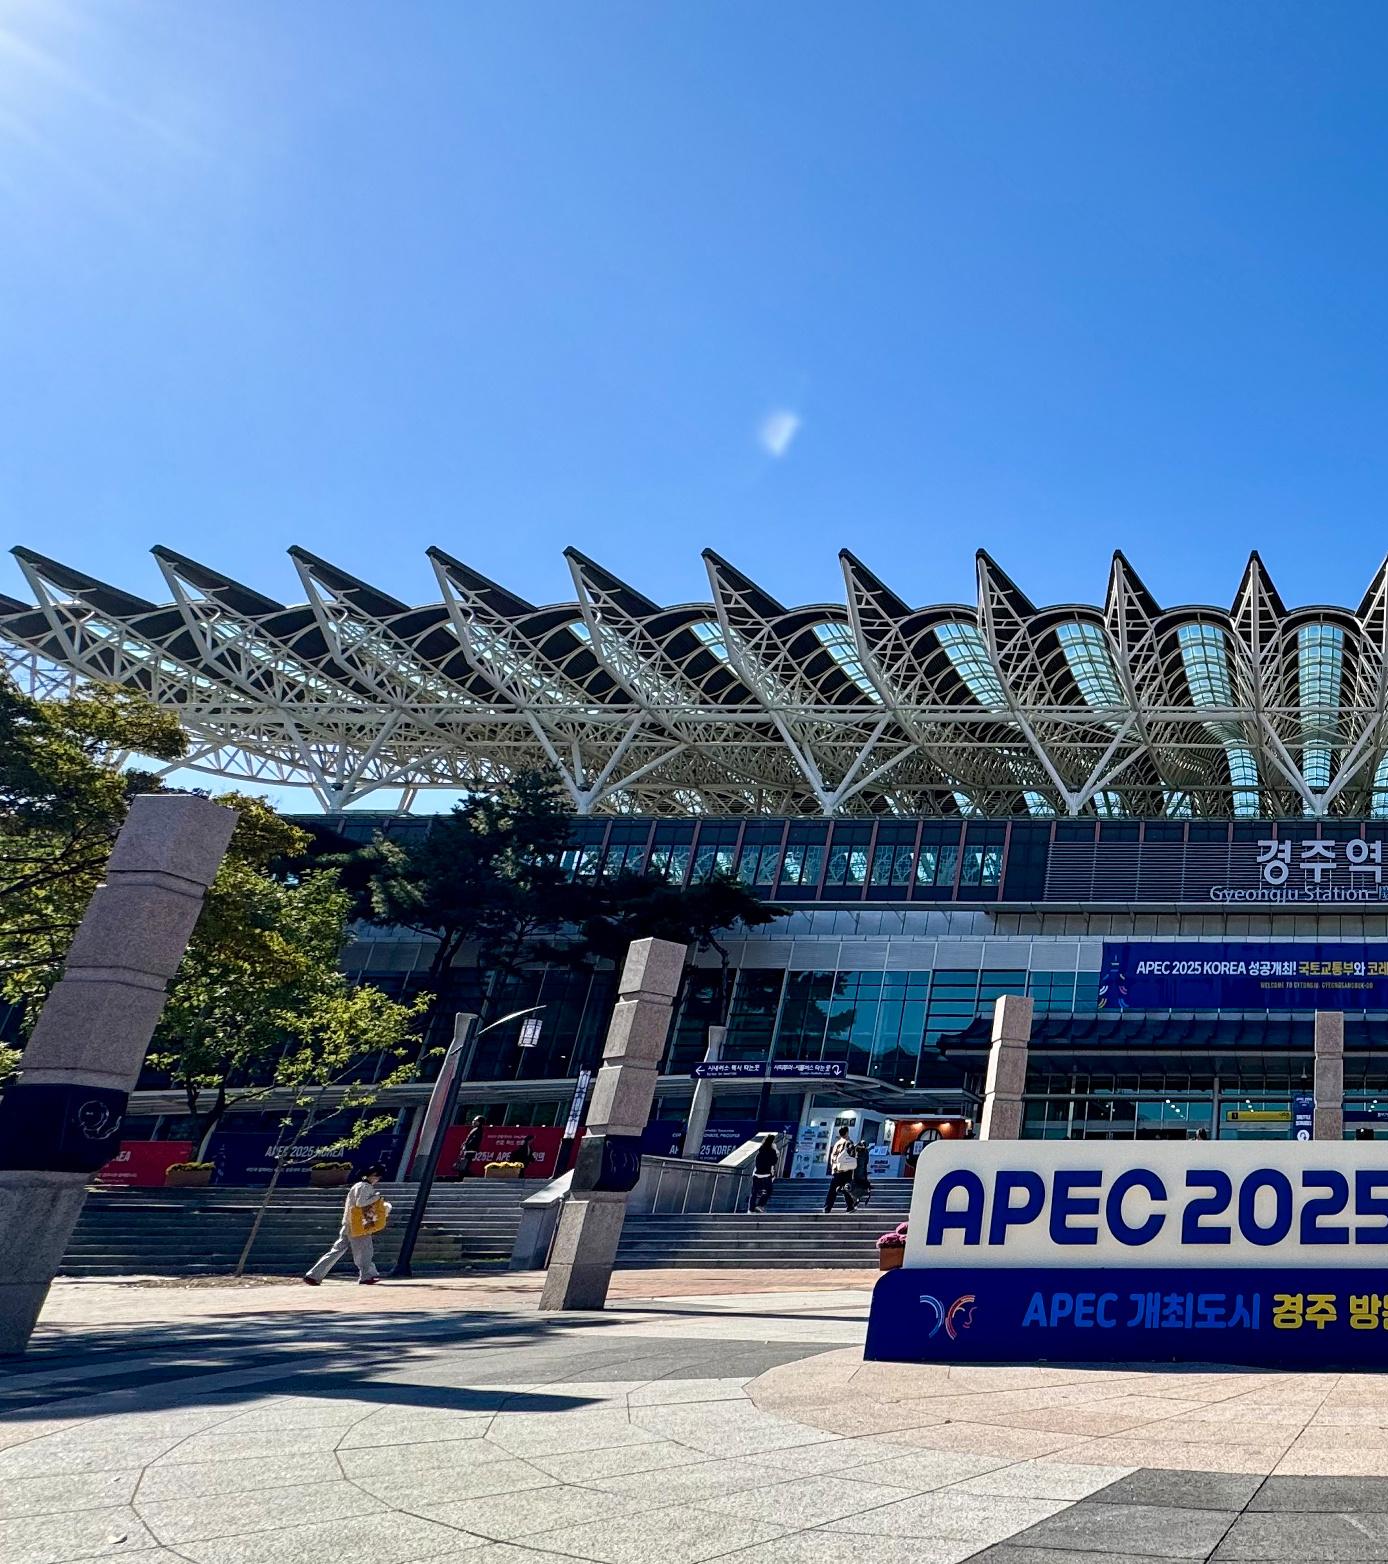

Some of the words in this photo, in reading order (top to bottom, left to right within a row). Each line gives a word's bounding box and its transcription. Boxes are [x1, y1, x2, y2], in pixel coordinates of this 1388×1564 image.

[1256, 838, 1382, 885] 경주역
[1209, 885, 1298, 903] Gyeongju
[1304, 885, 1369, 901] Station
[1136, 961, 1170, 975] APEC
[1172, 961, 1202, 975] 2025
[1204, 961, 1247, 975] KOREA
[1248, 960, 1297, 976] 성공개최!
[1298, 961, 1365, 977] 국토교통부와
[927, 1169, 1167, 1246] APEC
[1022, 1291, 1118, 1328] APEC
[1127, 1292, 1261, 1330] 개최도시
[1272, 1292, 1338, 1330] 경주
